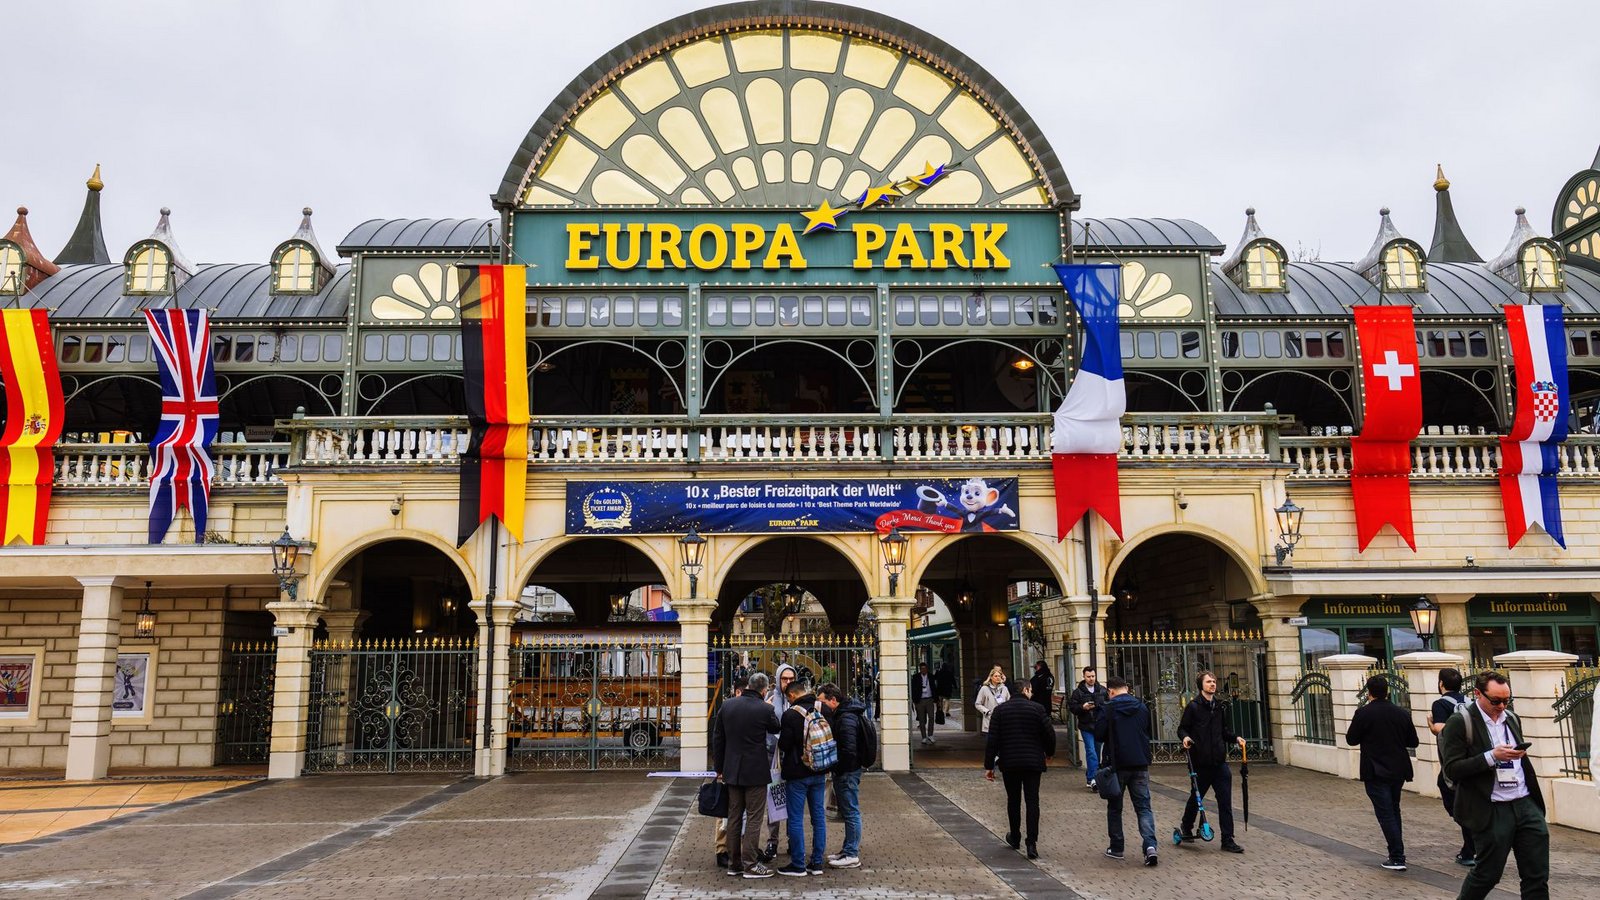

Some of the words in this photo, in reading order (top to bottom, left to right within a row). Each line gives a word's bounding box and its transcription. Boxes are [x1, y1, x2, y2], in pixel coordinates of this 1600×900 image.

[565, 222, 807, 270] EUROPA
[852, 222, 1011, 270] PARK
[685, 485, 700, 498] 10
[701, 487, 710, 498] x
[713, 485, 761, 500] „Bester
[765, 484, 839, 499] Freizeitpark
[842, 484, 863, 497] der
[867, 483, 902, 497] Welt“
[725, 502, 739, 510] parc
[748, 501, 767, 509] loisirs
[768, 519, 797, 527] EUROPA
[799, 519, 819, 527] PARK
[880, 516, 899, 527] Danke
[902, 513, 922, 522] Merci
[925, 516, 943, 527] Thank
[943, 523, 955, 531] you
[1324, 602, 1401, 614] Information
[1490, 600, 1567, 612] Information
